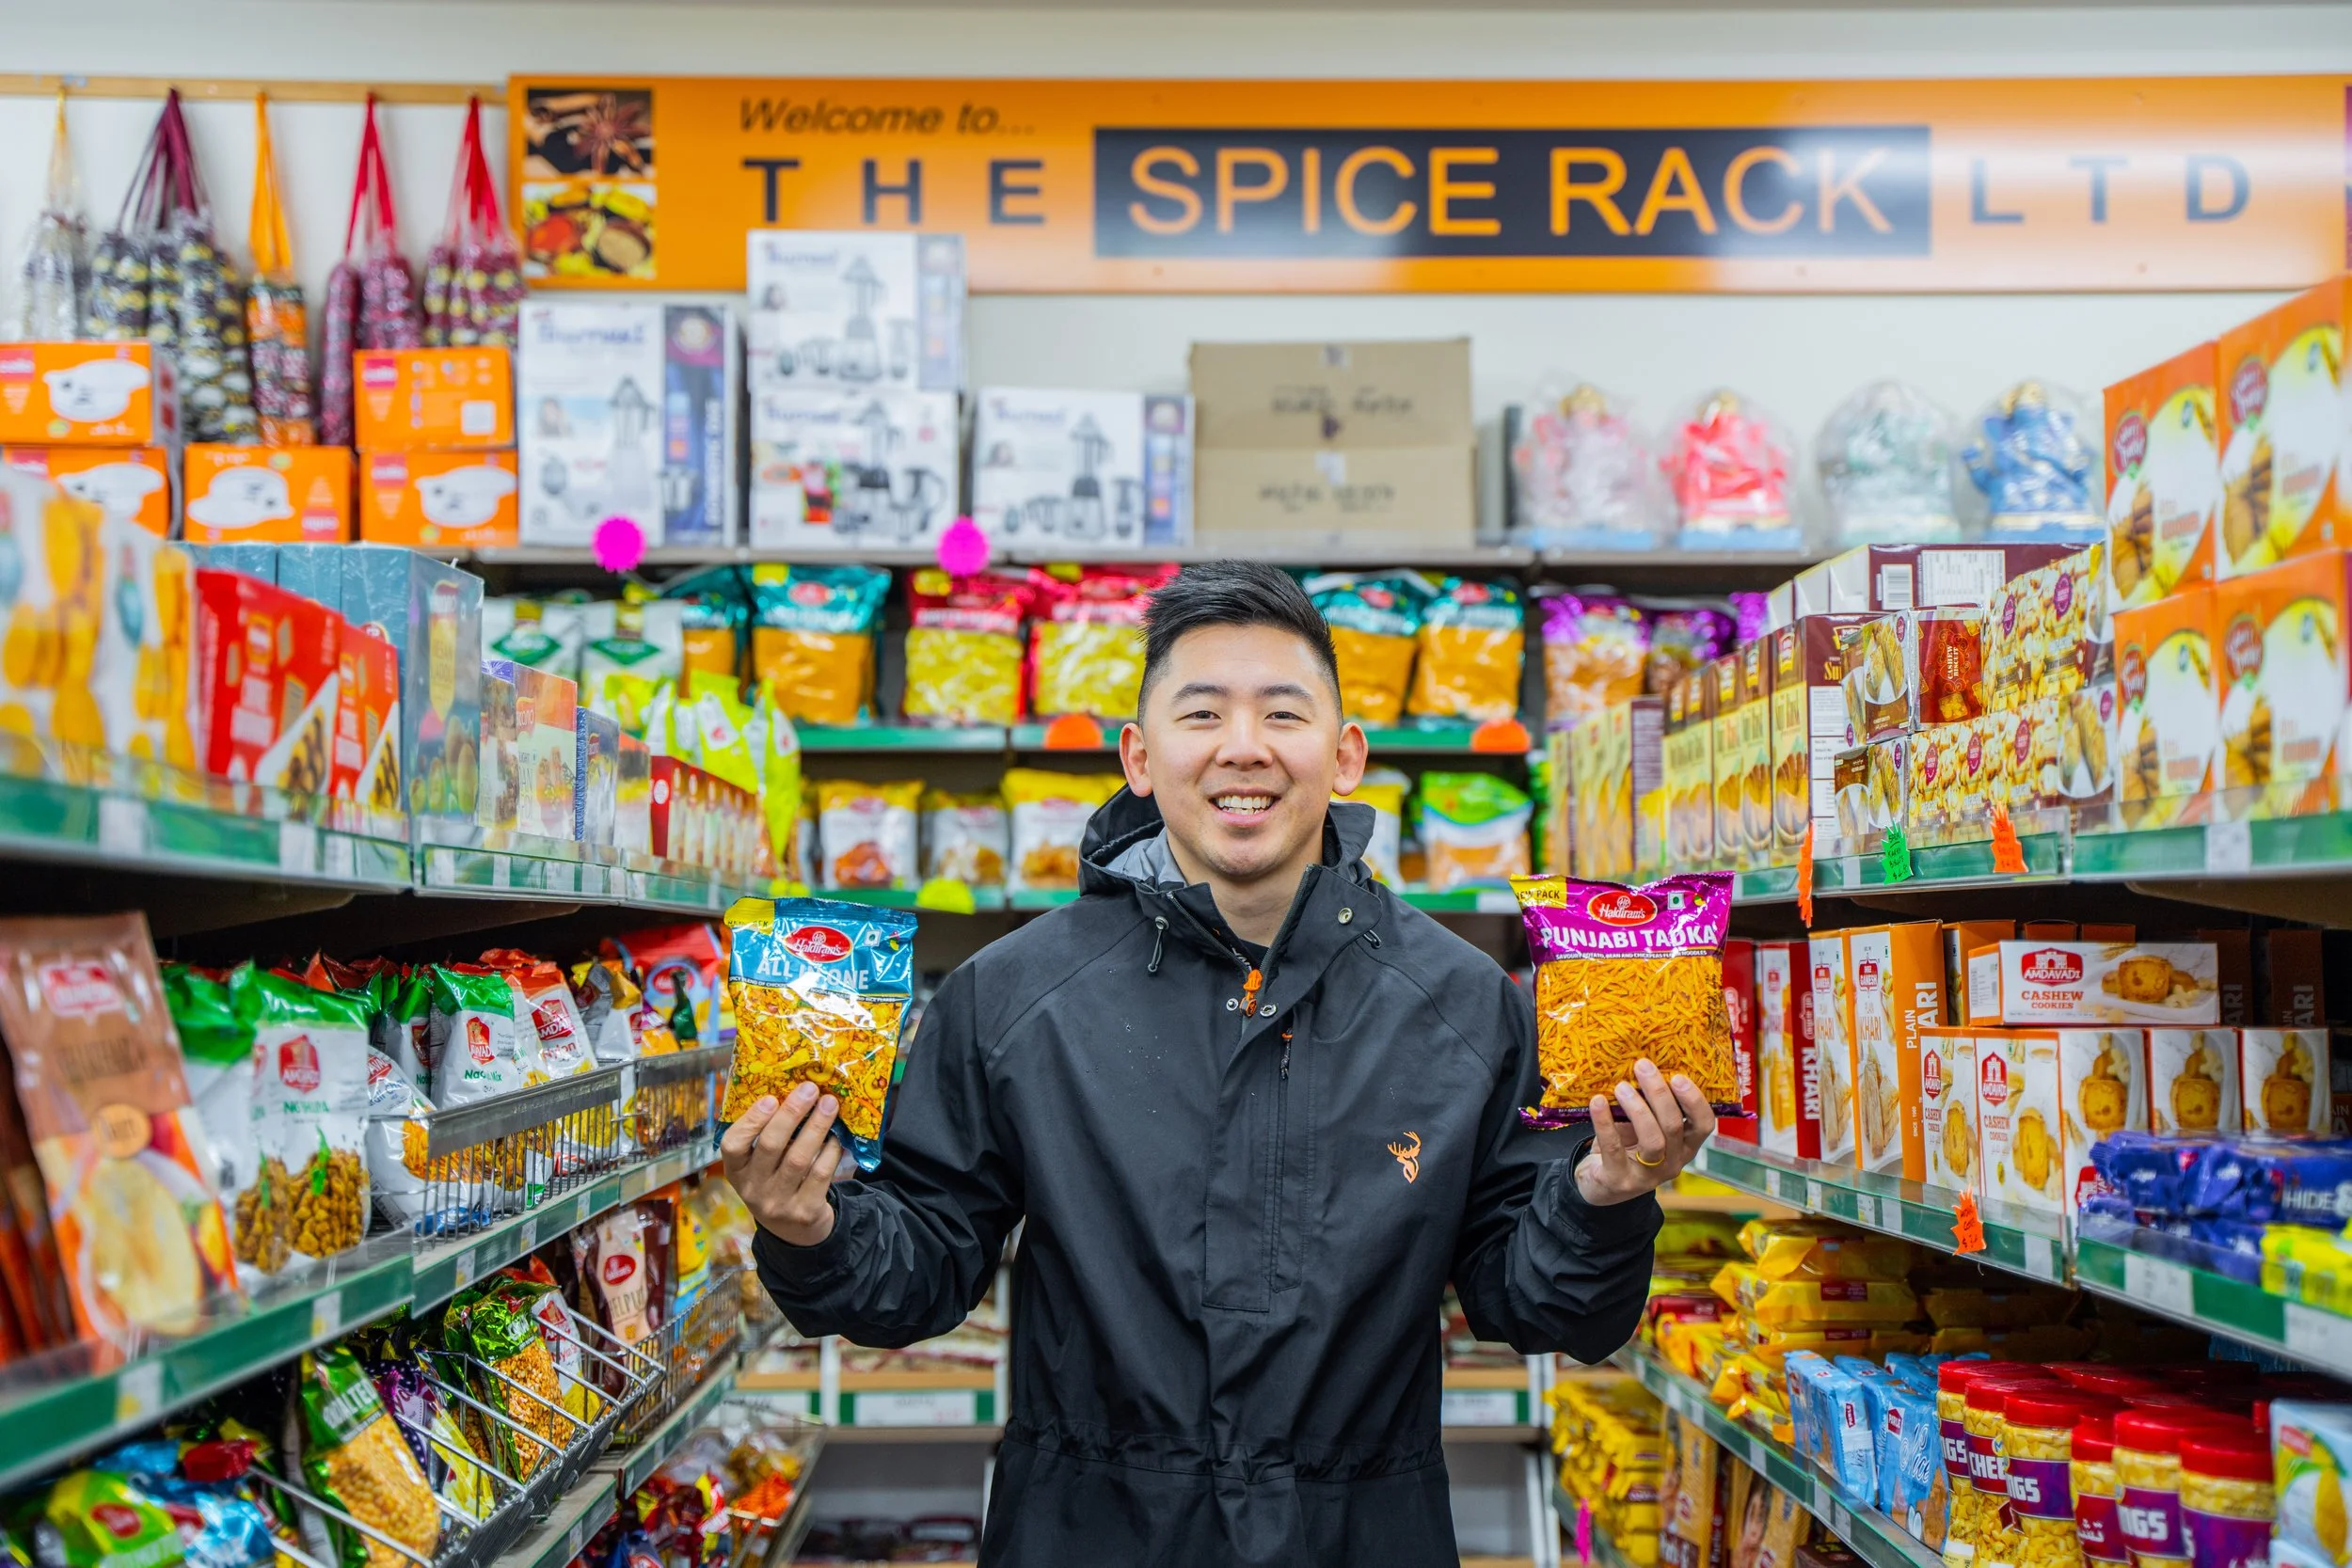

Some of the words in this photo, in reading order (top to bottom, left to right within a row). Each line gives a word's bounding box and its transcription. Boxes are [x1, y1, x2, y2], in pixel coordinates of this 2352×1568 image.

[740, 99, 945, 135] Welcome
[741, 158, 1046, 225] THE
[1130, 146, 1502, 235] SPICE
[1549, 146, 1894, 236] RACK
[1970, 154, 2251, 225] LTD
[1536, 890, 1561, 900] PACK
[1599, 905, 1646, 920] Haldiram's
[795, 940, 842, 956] Haldiram's
[1540, 927, 1638, 949] PUNJABI
[1640, 925, 1719, 948] TADKA
[756, 958, 794, 978] ALL
[827, 969, 869, 990] ONE
[2023, 968, 2081, 980] AMDAVADI
[1915, 982, 1940, 1027] ARI
[2021, 990, 2084, 1002] CASHEW
[2031, 1002, 2074, 1010] COOKIES
[2223, 983, 2243, 1026] ARI
[2293, 985, 2314, 1027] ARI
[1860, 1016, 1882, 1041] KHARI
[1904, 1009, 1918, 1049] PLAIN
[1801, 1046, 1820, 1120] KHARI
[1983, 1115, 2010, 1130] CASHEW
[1887, 1413, 1903, 1431] PARLE
